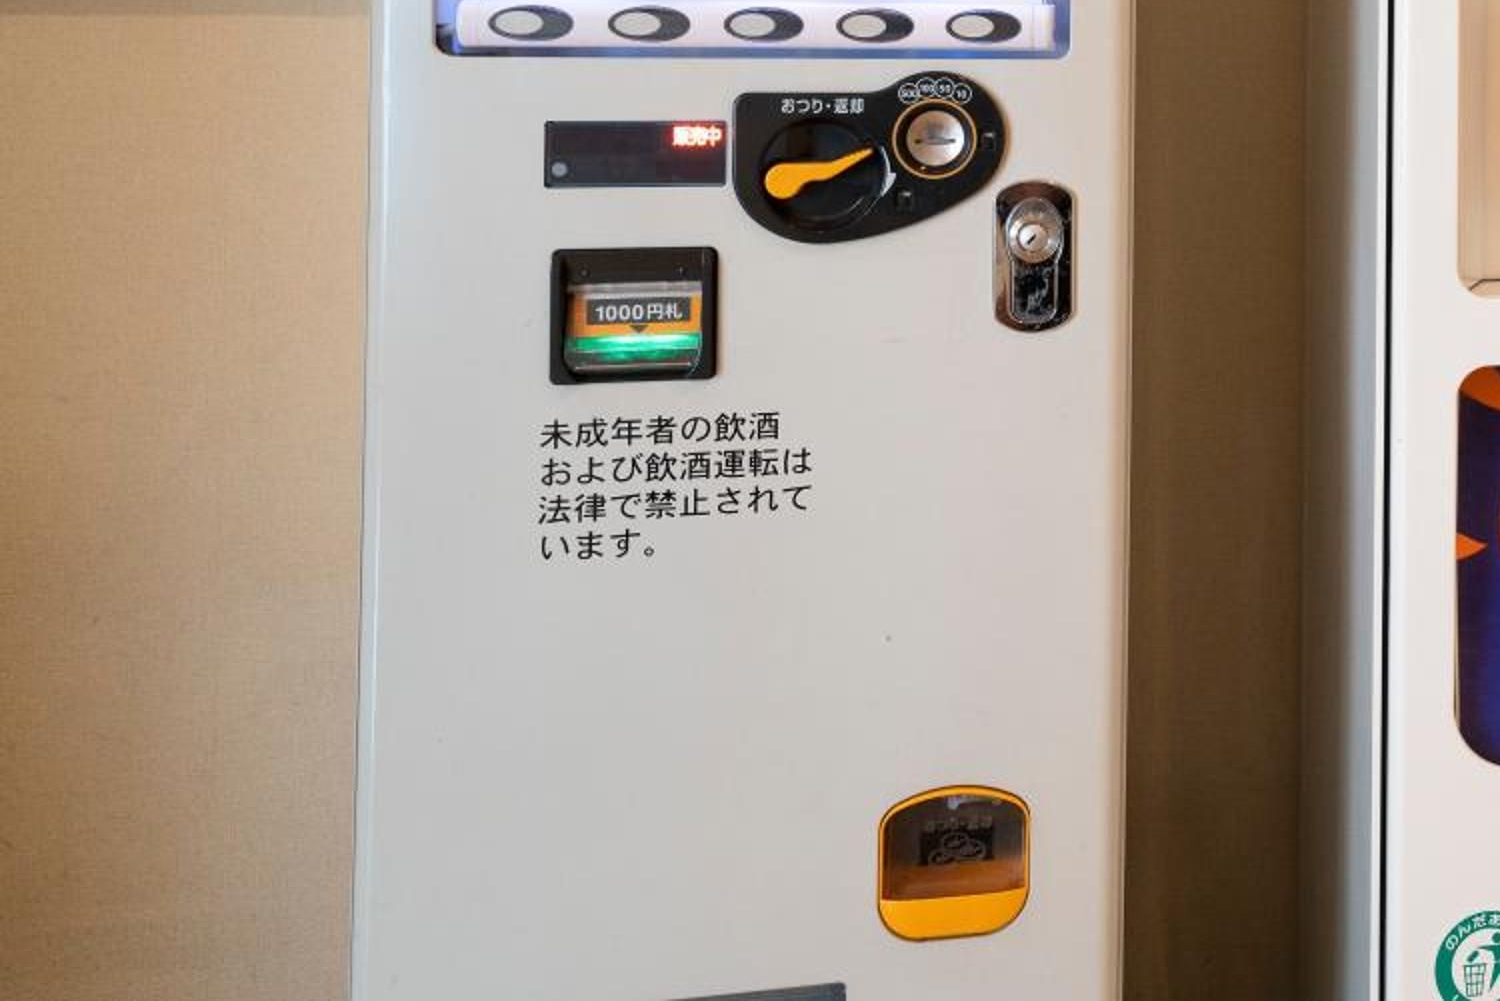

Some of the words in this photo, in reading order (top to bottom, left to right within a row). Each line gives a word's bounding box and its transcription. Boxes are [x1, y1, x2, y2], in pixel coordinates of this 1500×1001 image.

[780, 98, 865, 114] おつり・返却
[594, 302, 684, 324] 1000円札
[539, 410, 781, 449] 未成年者の飲酒
[539, 446, 813, 487] および飲酒運転は
[537, 484, 813, 525] 法律で禁止されて
[540, 529, 656, 561] います。
